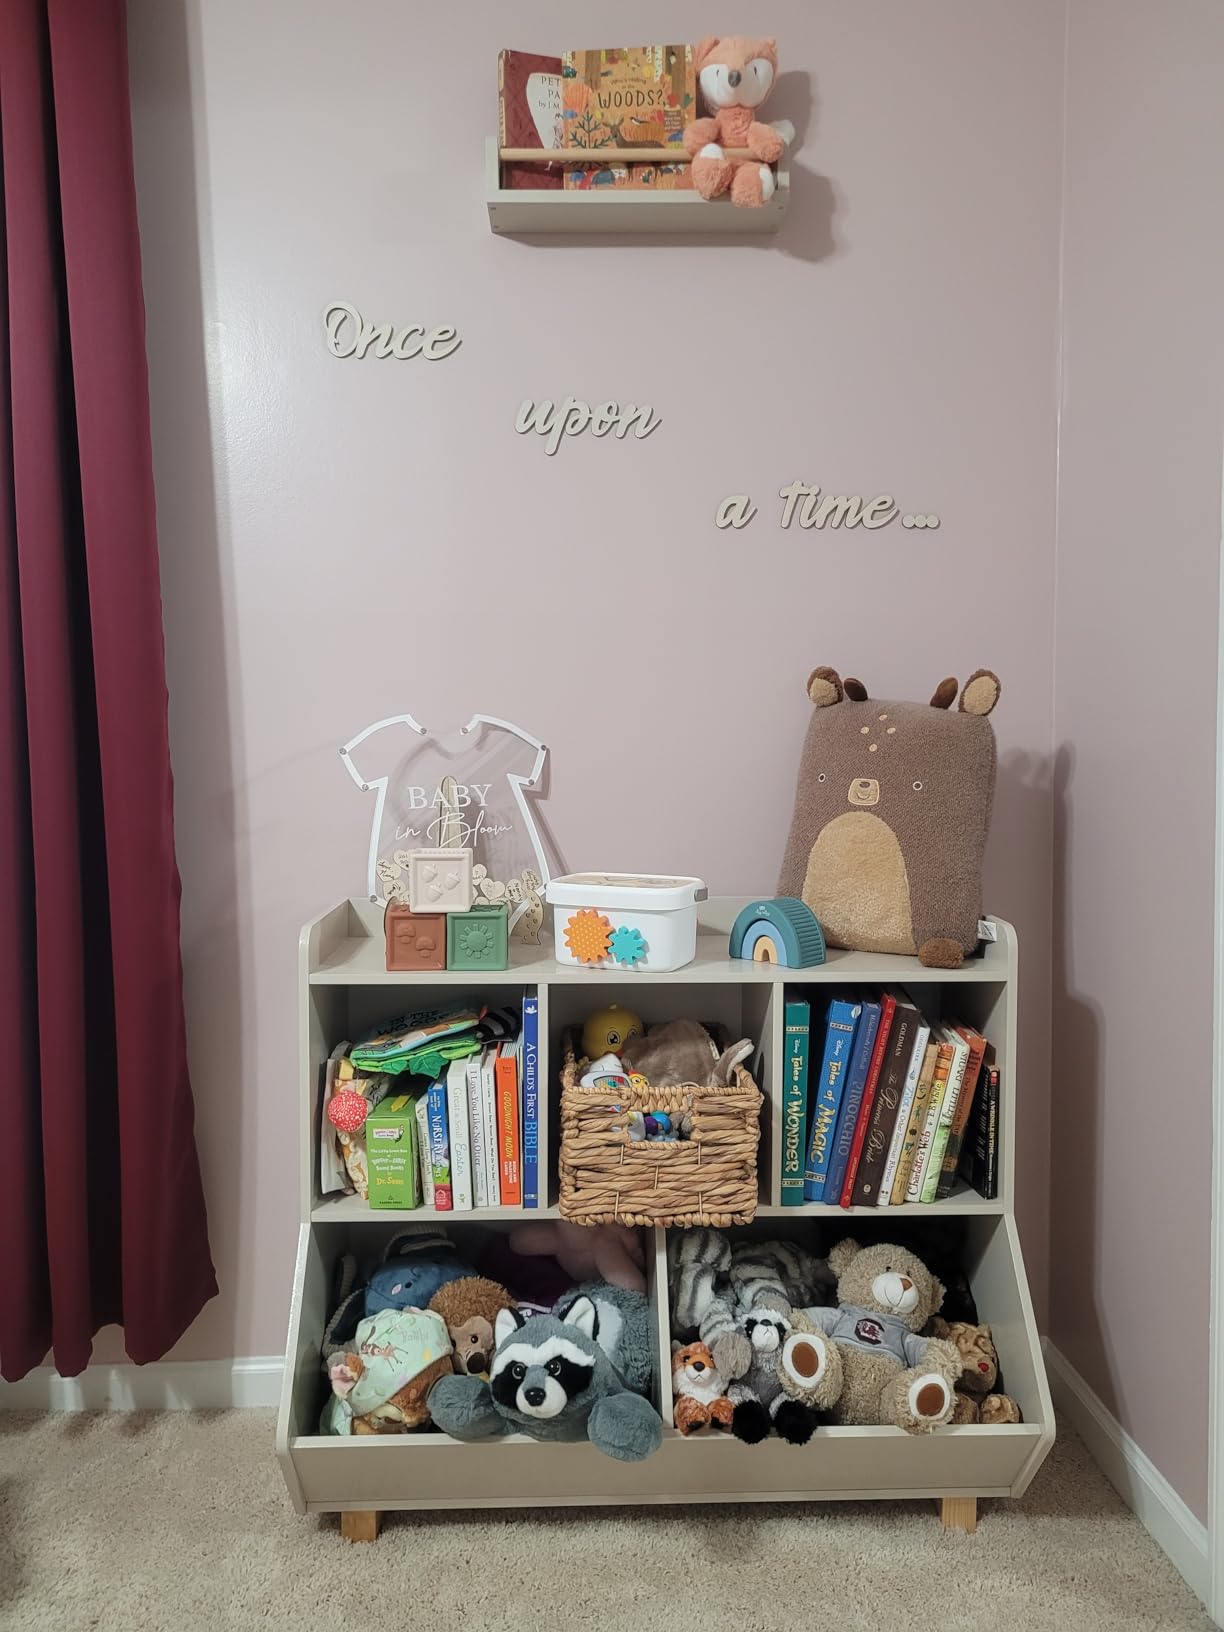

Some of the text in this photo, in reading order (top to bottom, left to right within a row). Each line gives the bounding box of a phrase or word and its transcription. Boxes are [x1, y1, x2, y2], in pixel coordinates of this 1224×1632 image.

[598, 90, 663, 109] WOODS?
[324, 300, 463, 360] Once
[514, 397, 663, 456] upon
[715, 495, 758, 529] a
[407, 784, 492, 809] BABY
[395, 810, 513, 848] in Bloom
[895, 1022, 908, 1056] GOLDMAN
[790, 1056, 803, 1081] Tales
[828, 1061, 842, 1086] Tales
[888, 1073, 897, 1085] The
[955, 1051, 968, 1082] STUART
[470, 1076, 478, 1095] Love
[789, 1085, 802, 1096] of
[823, 1089, 836, 1103] of
[929, 1083, 942, 1104] White
[471, 1096, 479, 1111] You
[524, 1042, 538, 1164] A CHILD'S FIRST BIBLE
[838, 1081, 864, 1156] PINOCCHIO
[874, 1087, 899, 1125] Princess
[988, 1105, 997, 1131] WRINKLE
[431, 1115, 443, 1154] NURSERY
[472, 1113, 481, 1130] Like
[503, 1091, 513, 1159] GOODNIGHT MOON
[785, 1099, 805, 1173] WONDER
[810, 1103, 836, 1164] MAGIC
[473, 1132, 481, 1143] No
[865, 1129, 886, 1163] Bride
[455, 1143, 467, 1177] Easter
[474, 1144, 482, 1167] Otter
[906, 1130, 931, 1195] Charlotte's Web
[376, 1177, 386, 1185] Dr.
